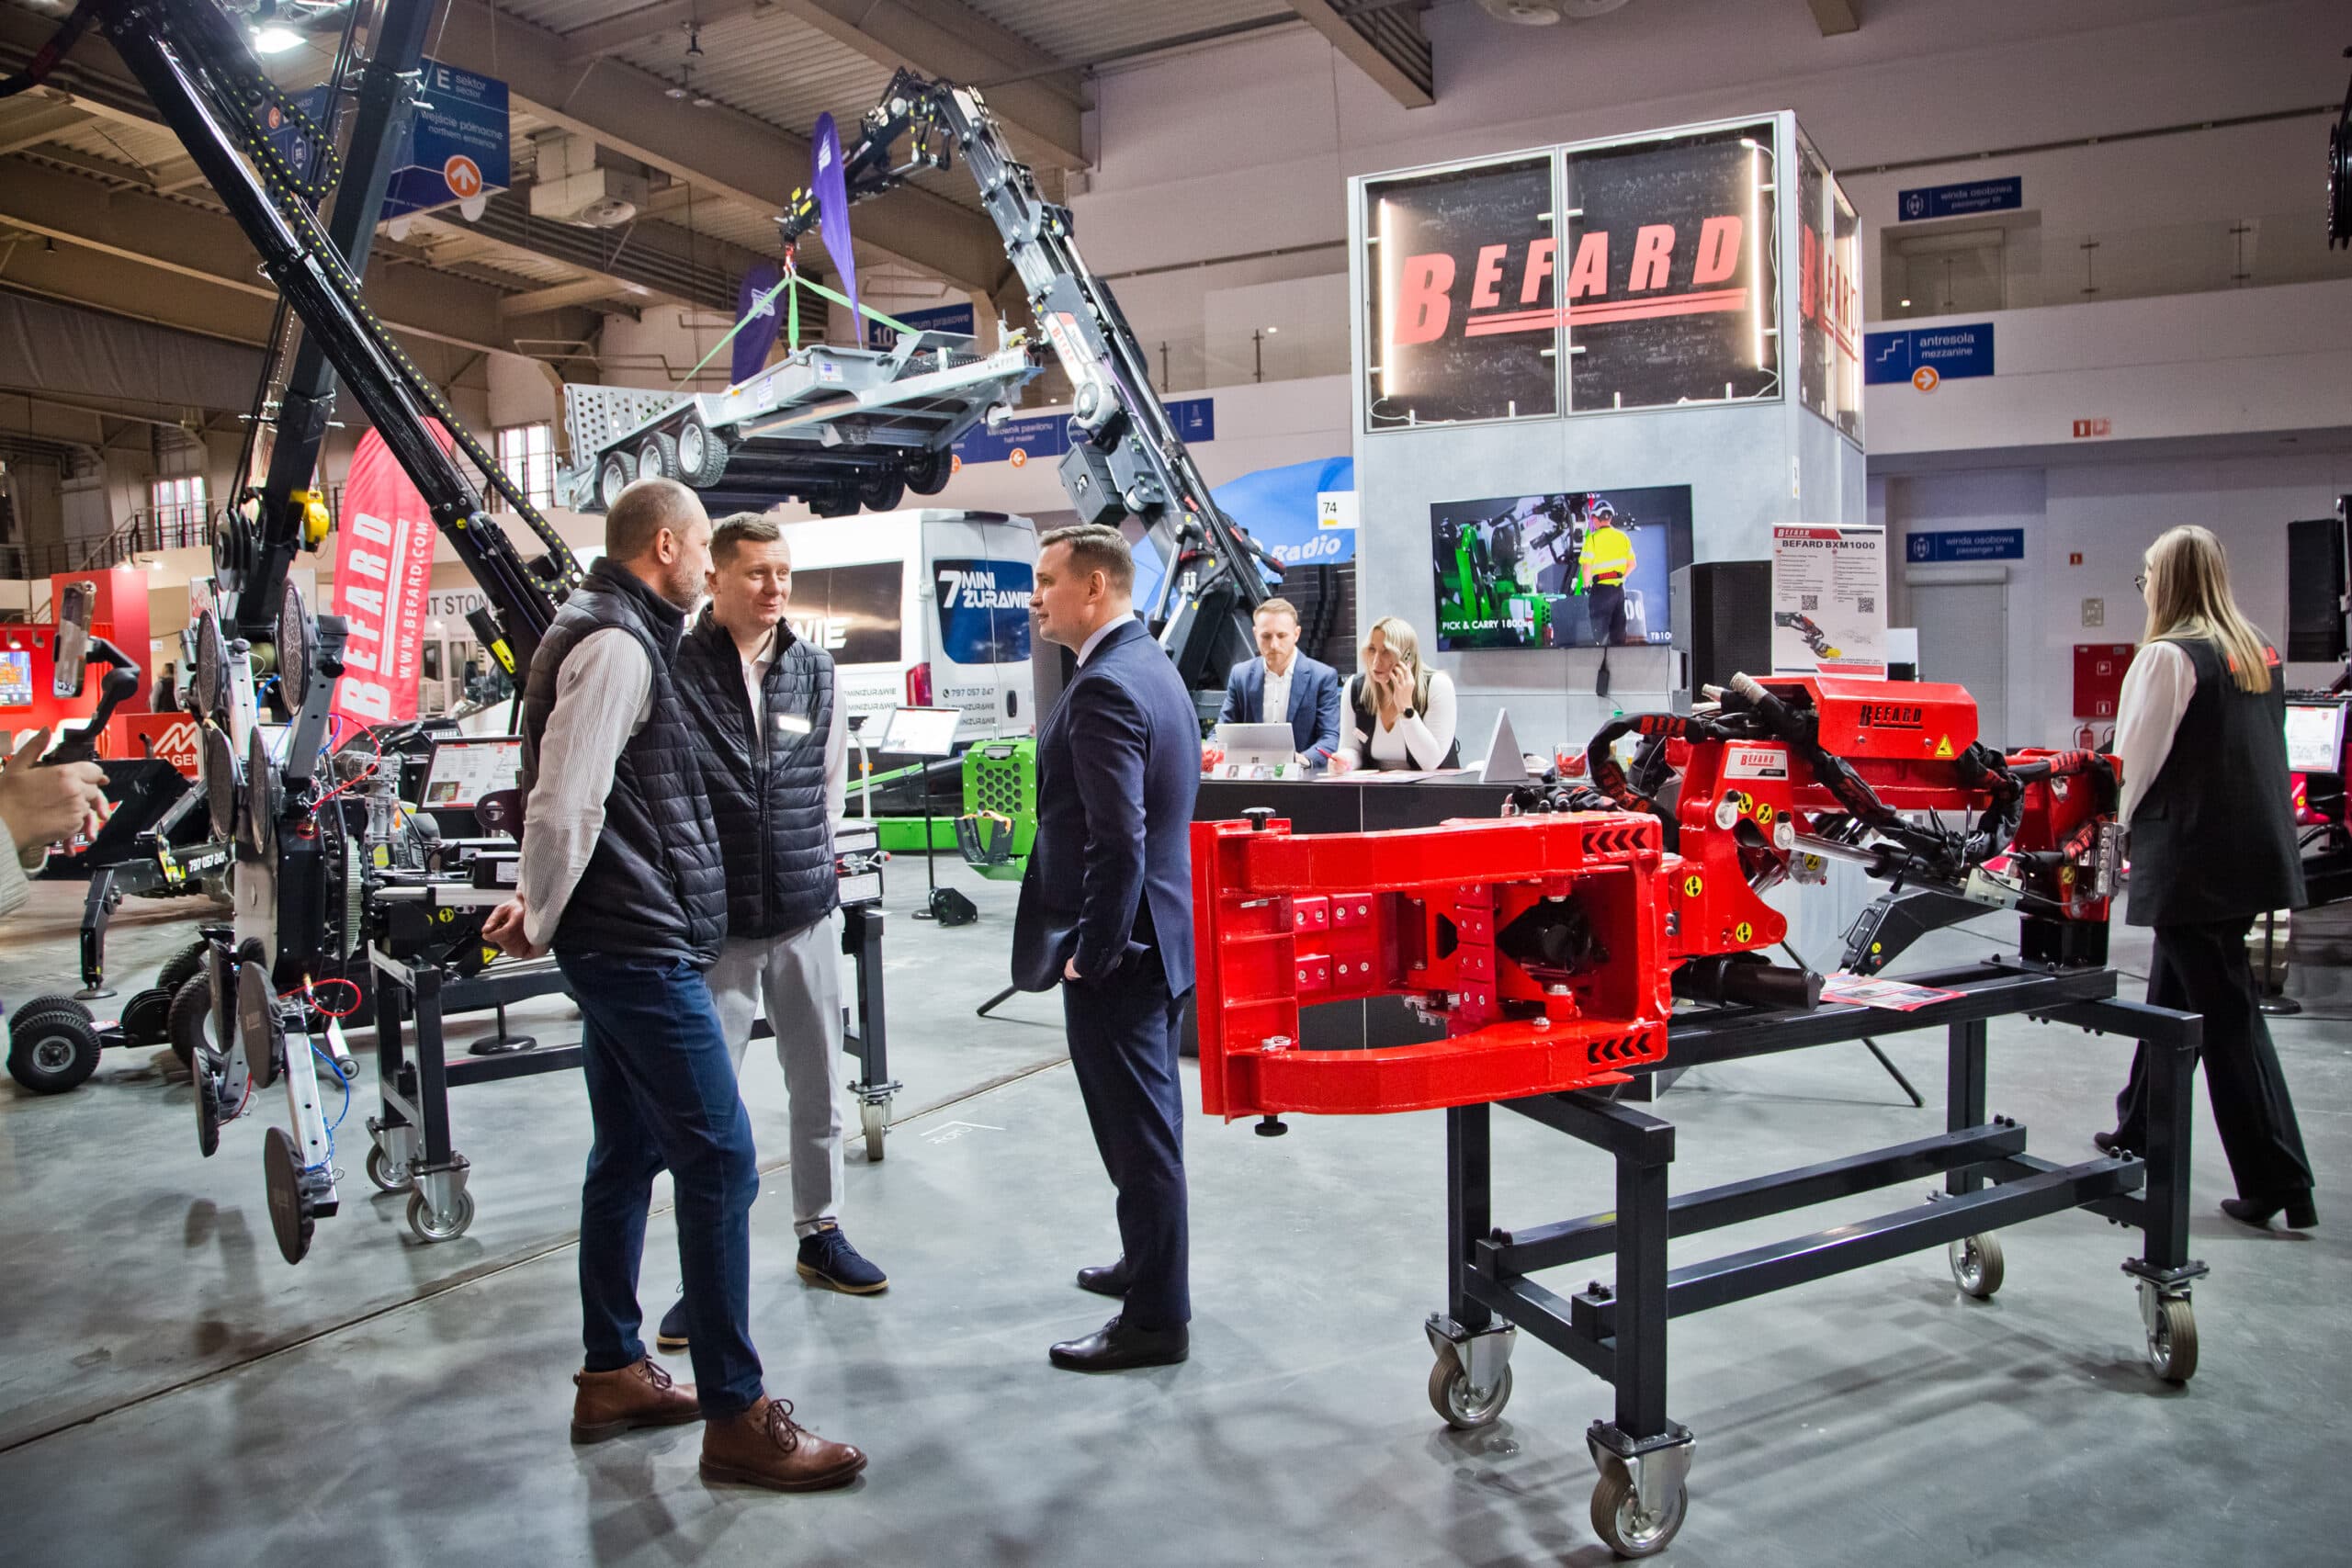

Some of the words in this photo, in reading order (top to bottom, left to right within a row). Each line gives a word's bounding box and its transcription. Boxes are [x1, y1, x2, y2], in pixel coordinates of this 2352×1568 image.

[436, 67, 451, 90] E
[456, 73, 486, 91] sektor
[1940, 188, 1967, 200] winda
[1970, 184, 2013, 197] osobowa
[1393, 215, 1743, 346] BEFARD
[875, 326, 894, 347] 10
[1919, 332, 1975, 347] antresola
[1922, 346, 1973, 358] mezzanine
[1323, 502, 1337, 513] 74
[1272, 535, 1341, 561] Radio
[1782, 539, 1823, 548] BEFARD
[1946, 536, 1972, 547] winda
[1973, 534, 2014, 545] osobowa
[938, 570, 962, 609] 7
[962, 571, 995, 589] MINI
[399, 522, 430, 679] WWW.BEFARD.COM
[340, 513, 392, 721] BEFARD
[1442, 621, 1462, 630] PICK
[1463, 620, 1470, 629] &
[1472, 619, 1498, 629] CARRY
[1639, 715, 1687, 735] BEFA
[1859, 705, 1923, 728] BEFARD
[1740, 753, 1775, 766] BEFARD
